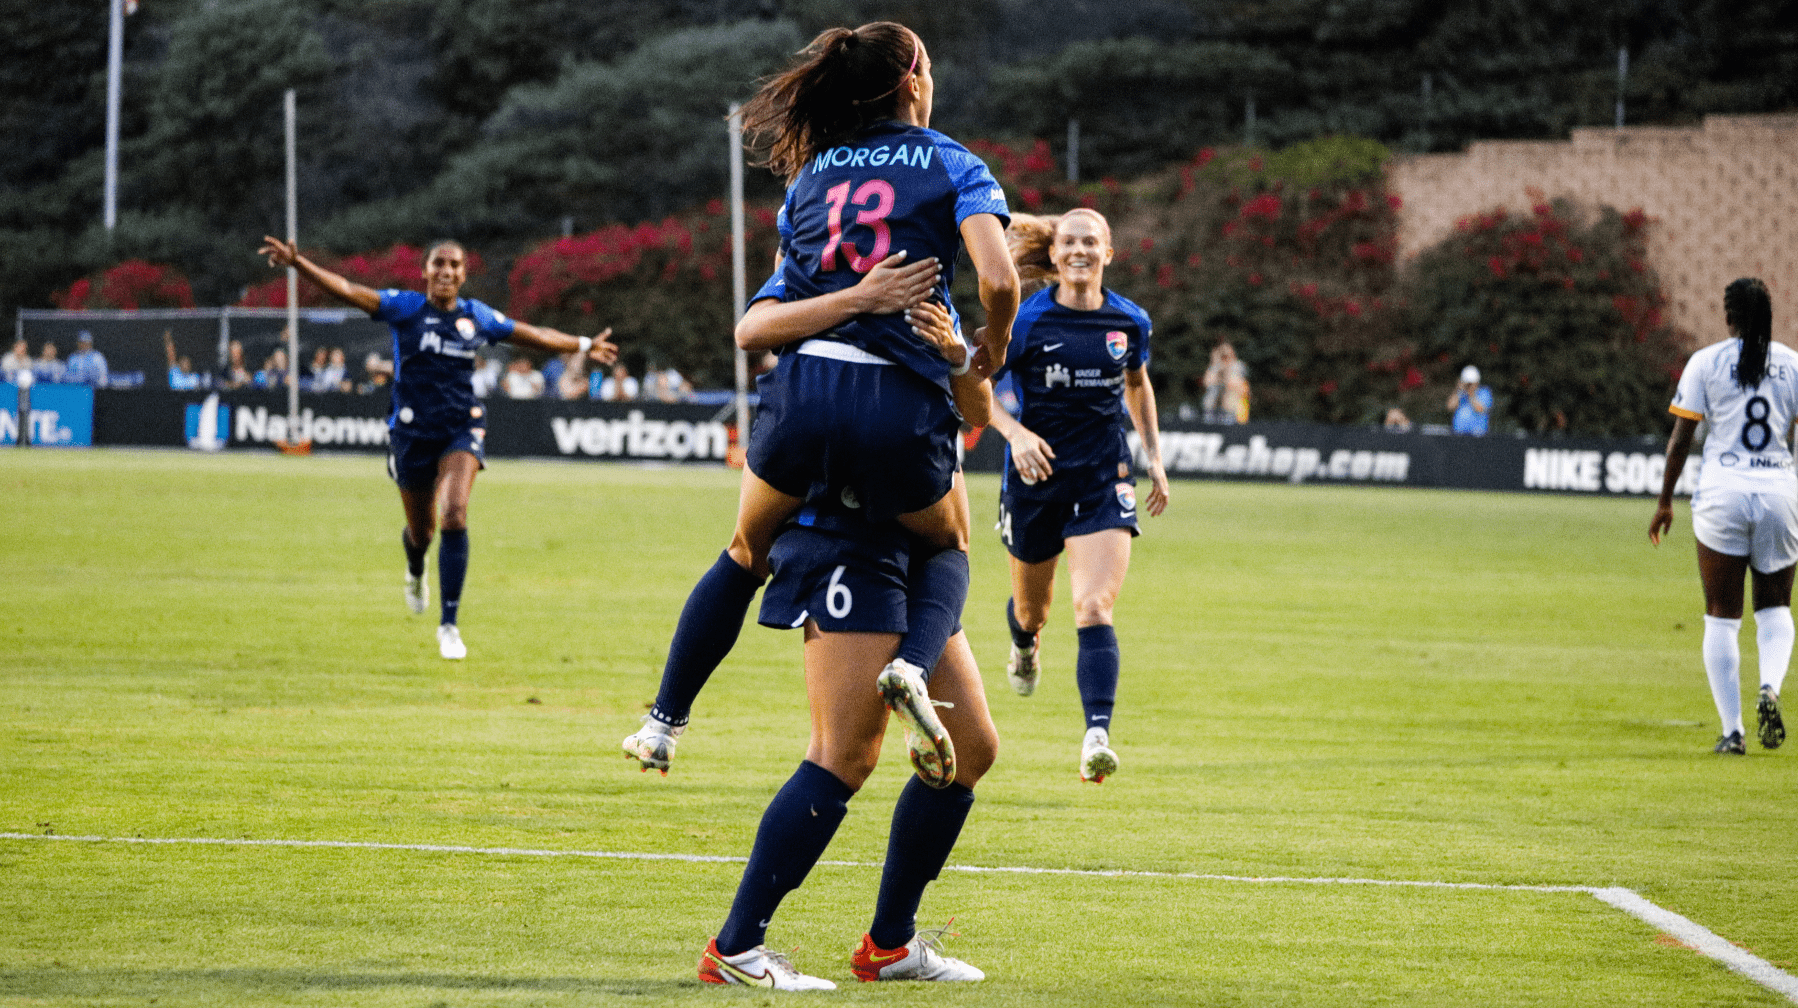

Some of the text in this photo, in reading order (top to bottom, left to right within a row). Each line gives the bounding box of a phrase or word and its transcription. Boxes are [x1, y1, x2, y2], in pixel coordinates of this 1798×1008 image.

[812, 144, 933, 175] MORGAN
[821, 179, 895, 273] 13
[1074, 377, 1126, 388] PERMAN
[551, 409, 728, 456] verizon
[1741, 396, 1772, 452] 8
[1523, 448, 1602, 492] NIKE
[826, 565, 853, 619] 6
